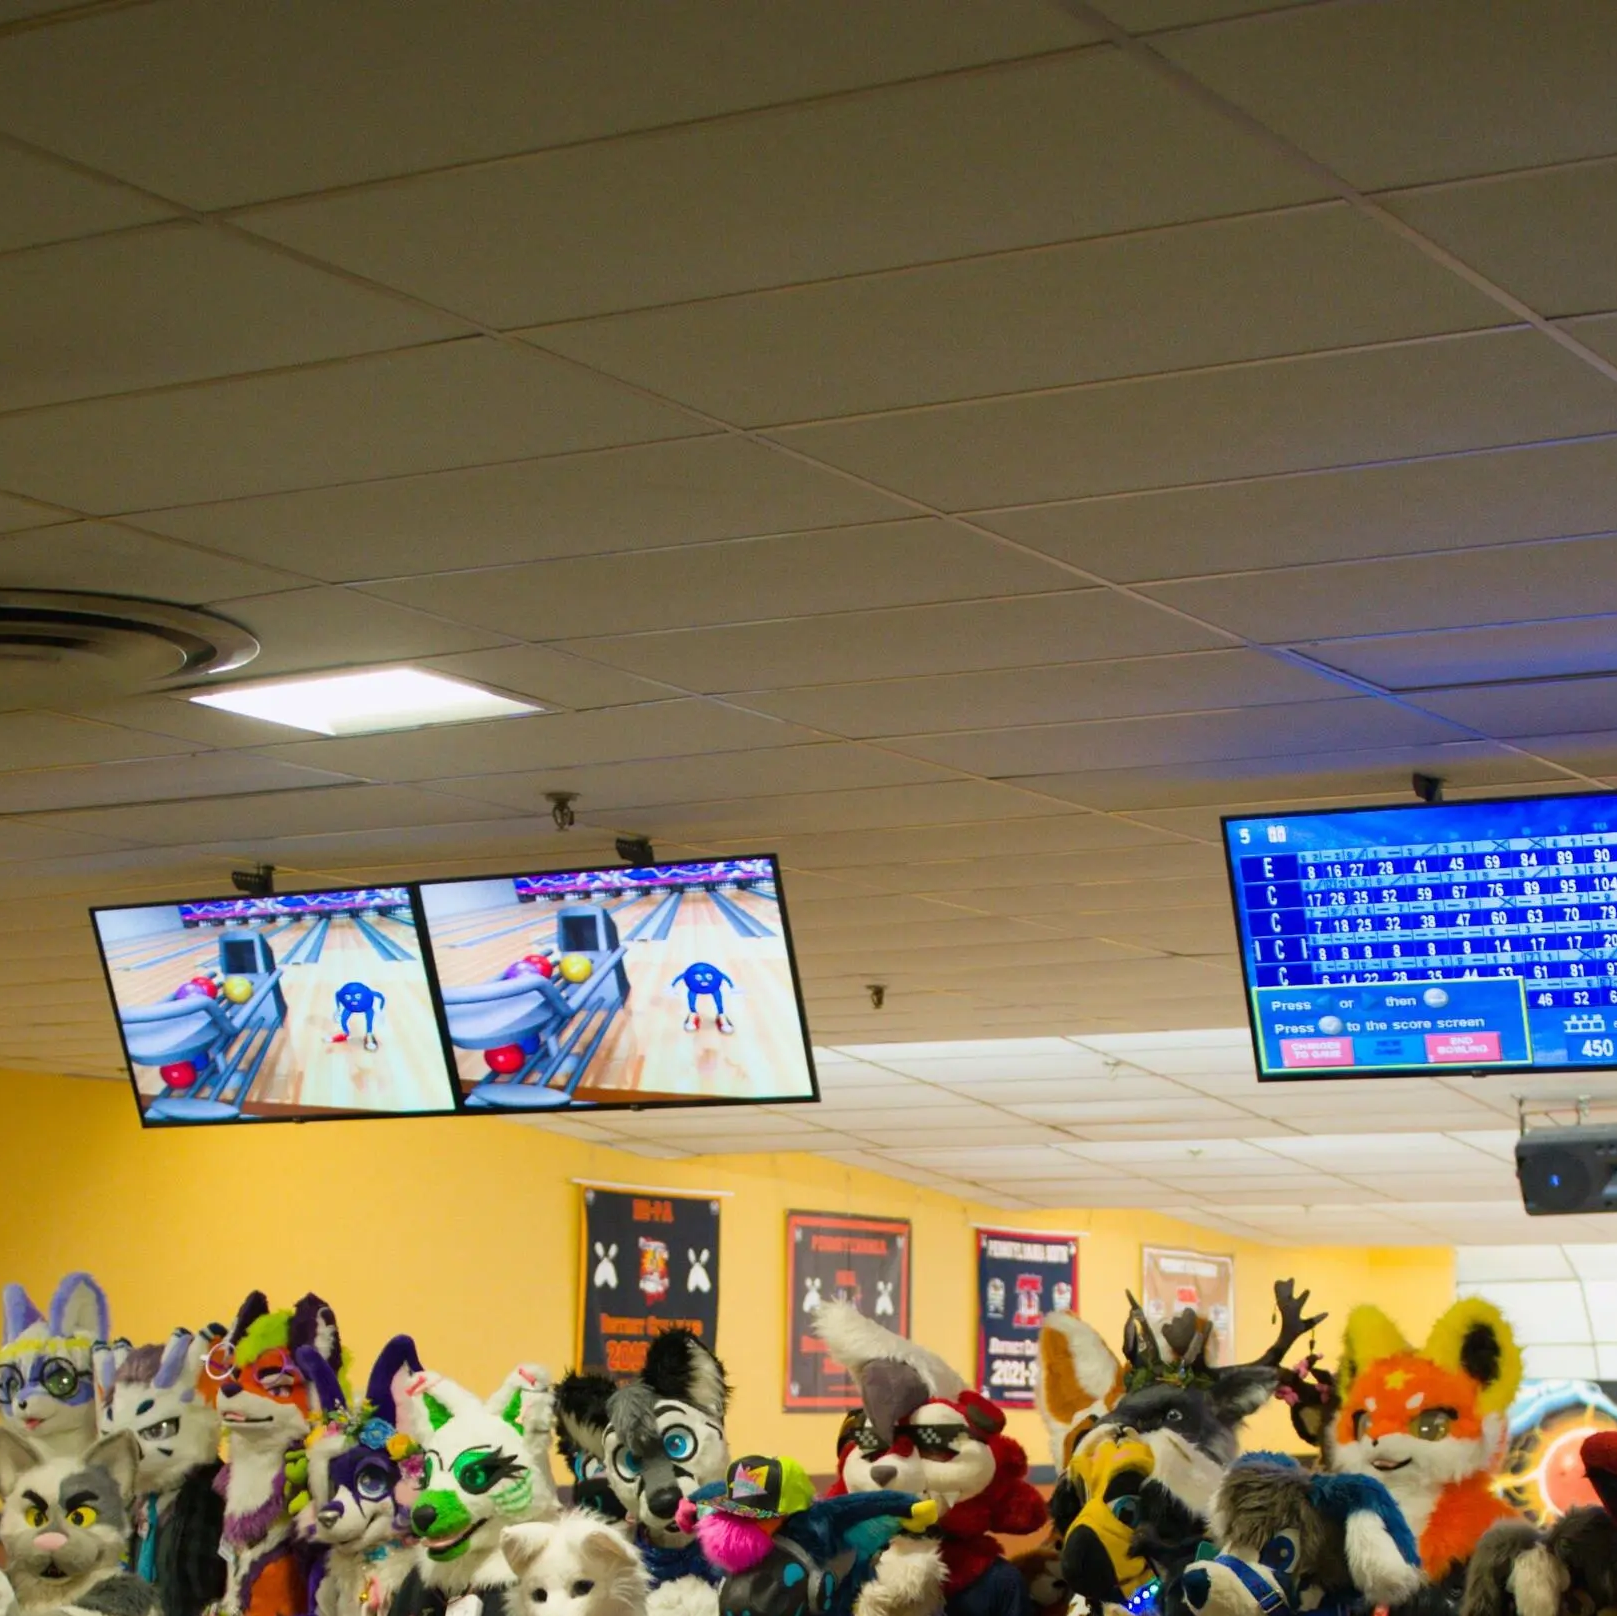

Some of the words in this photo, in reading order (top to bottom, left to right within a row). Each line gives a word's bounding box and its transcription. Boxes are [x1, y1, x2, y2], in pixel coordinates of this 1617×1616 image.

[1264, 858, 1274, 878] E
[1307, 866, 1315, 879] 8
[1327, 865, 1342, 877] 16
[1350, 864, 1364, 876] 27
[1378, 862, 1393, 875] 28
[1414, 860, 1427, 872] 41
[1450, 858, 1464, 870] 45
[1485, 855, 1500, 869] 69
[1521, 853, 1537, 866] 84
[1557, 851, 1573, 864] 89
[1594, 849, 1610, 862] 90
[1268, 886, 1277, 905] C
[1308, 894, 1321, 907] 17
[1330, 893, 1345, 905] 26
[1354, 891, 1368, 903] 35
[1383, 889, 1397, 902] 52
[1418, 888, 1432, 900] 59
[1452, 886, 1467, 898] 67
[1488, 883, 1504, 897] 76
[1524, 881, 1540, 895] 89
[1560, 880, 1576, 892] 95
[1594, 877, 1617, 891] 104
[1271, 913, 1281, 933] C
[1316, 922, 1322, 934] 7
[1334, 920, 1348, 932] 18
[1357, 919, 1372, 931] 25
[1386, 917, 1400, 930] 32
[1421, 915, 1435, 927] 38
[1456, 913, 1471, 926] 47
[1491, 911, 1507, 924] 60
[1527, 909, 1543, 923] 63
[1563, 908, 1579, 920] 70
[1601, 906, 1616, 919] 79
[1275, 940, 1285, 959] C
[1319, 948, 1326, 960] 8
[1342, 947, 1349, 959] 8
[1364, 946, 1372, 958] 8
[1393, 945, 1400, 957] 8
[1428, 943, 1436, 955] 8
[1463, 941, 1471, 954] 8
[1495, 939, 1511, 952] 14
[1530, 938, 1545, 950] 17
[1567, 937, 1582, 949] 17
[1278, 967, 1288, 985] C
[1535, 966, 1547, 979] 61
[1570, 964, 1584, 977] 81
[1272, 1000, 1311, 1011] Press
[1340, 999, 1354, 1009] or
[1385, 997, 1416, 1007] then
[1538, 993, 1553, 1006] 46
[1574, 992, 1589, 1004] 52
[1275, 1024, 1315, 1034] Press
[1347, 1022, 1360, 1032] to
[1366, 1021, 1387, 1031] the
[1393, 1020, 1431, 1029] score
[1437, 1018, 1484, 1028] screen
[1582, 1039, 1613, 1056] 450
